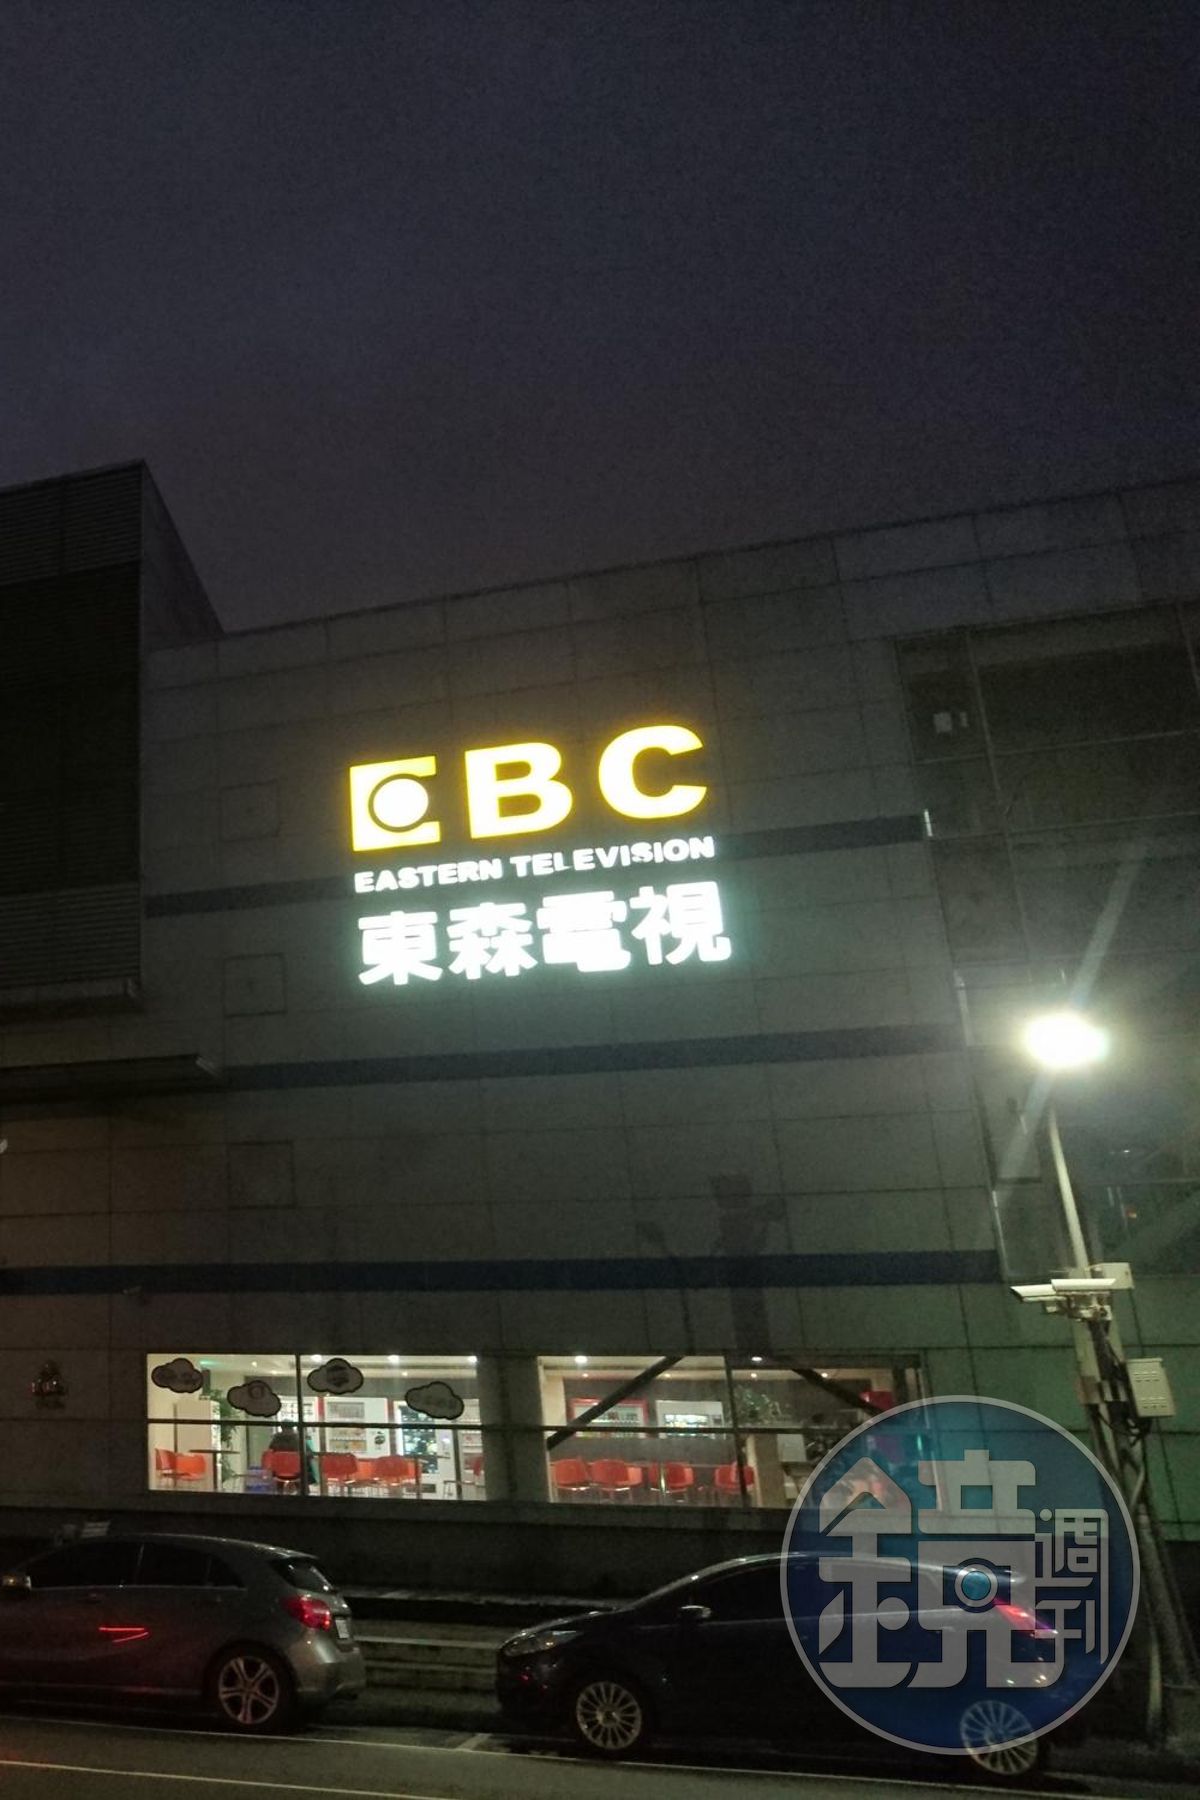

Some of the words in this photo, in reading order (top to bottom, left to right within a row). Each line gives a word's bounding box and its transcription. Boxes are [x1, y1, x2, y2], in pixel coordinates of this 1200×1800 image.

[349, 725, 707, 851] EBC
[354, 858, 503, 893] EASTERN
[510, 836, 715, 877] TELEVISION
[358, 881, 732, 985] 東森電視
